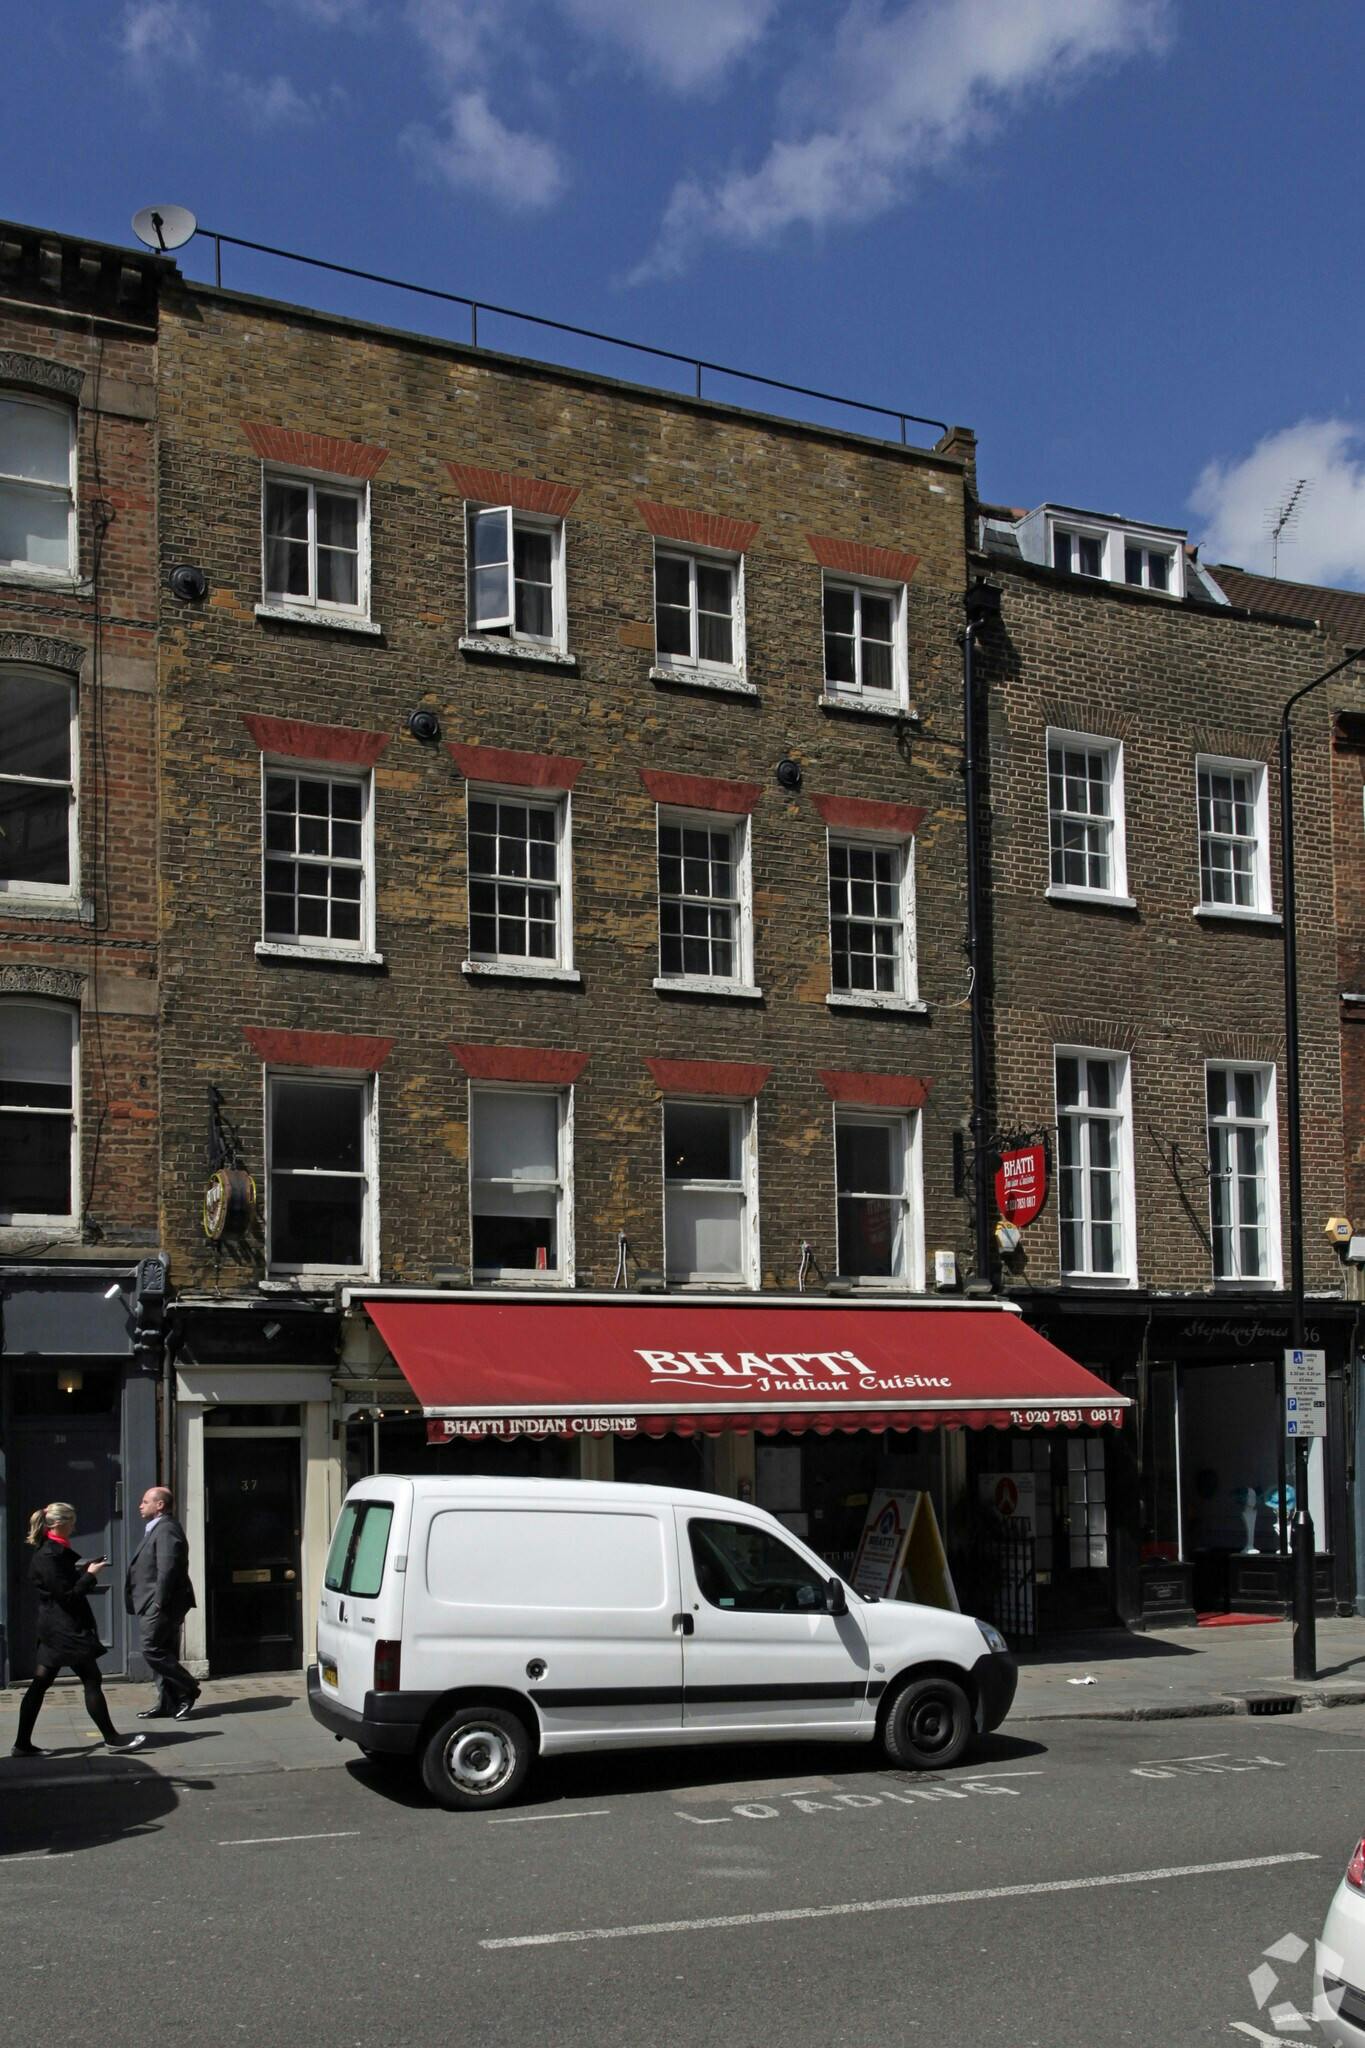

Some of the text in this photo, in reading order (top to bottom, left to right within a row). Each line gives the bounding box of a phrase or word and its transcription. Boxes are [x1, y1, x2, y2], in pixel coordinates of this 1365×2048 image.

[757, 1374, 952, 1392] Indian Cuisine
[1025, 1411, 1050, 1423] 020
[1090, 1409, 1121, 1421] 0817
[509, 1419, 567, 1433] INDIAN
[571, 1417, 637, 1433] CUISINE
[674, 1782, 1021, 1824] LOADING
